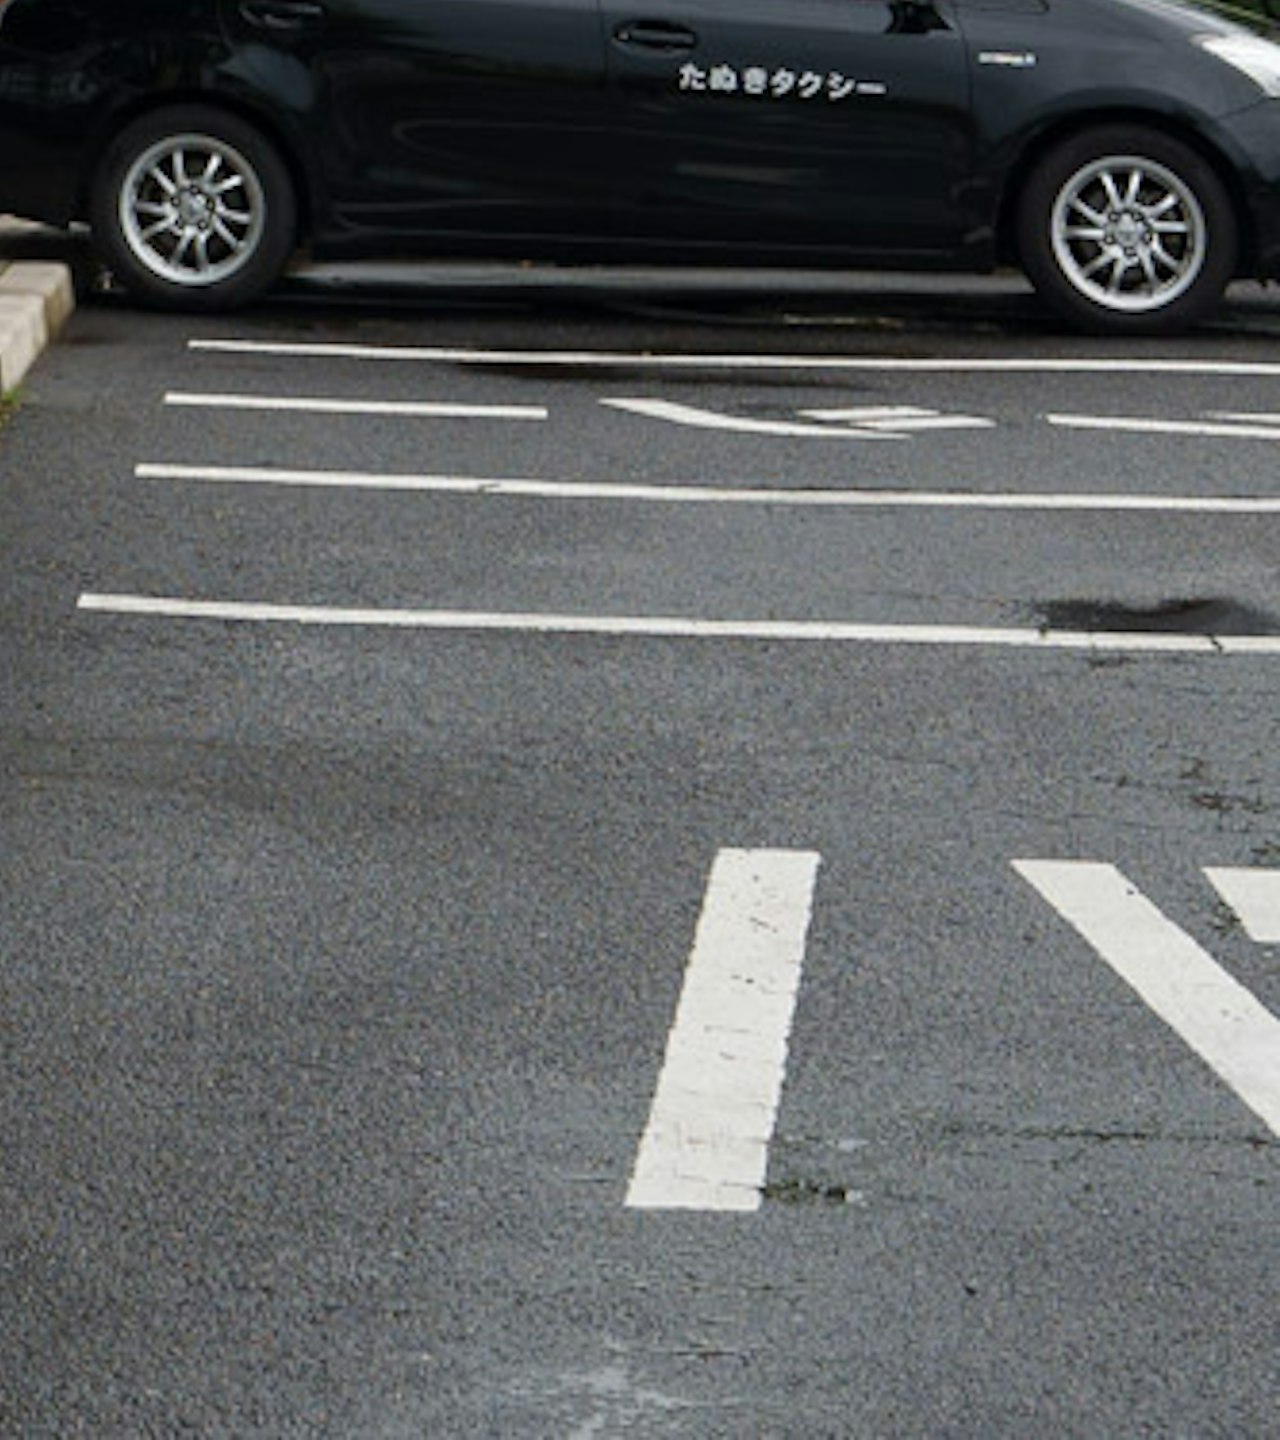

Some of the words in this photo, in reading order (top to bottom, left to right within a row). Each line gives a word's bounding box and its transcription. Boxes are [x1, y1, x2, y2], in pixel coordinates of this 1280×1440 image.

[679, 63, 887, 100] たぬきタクシー
